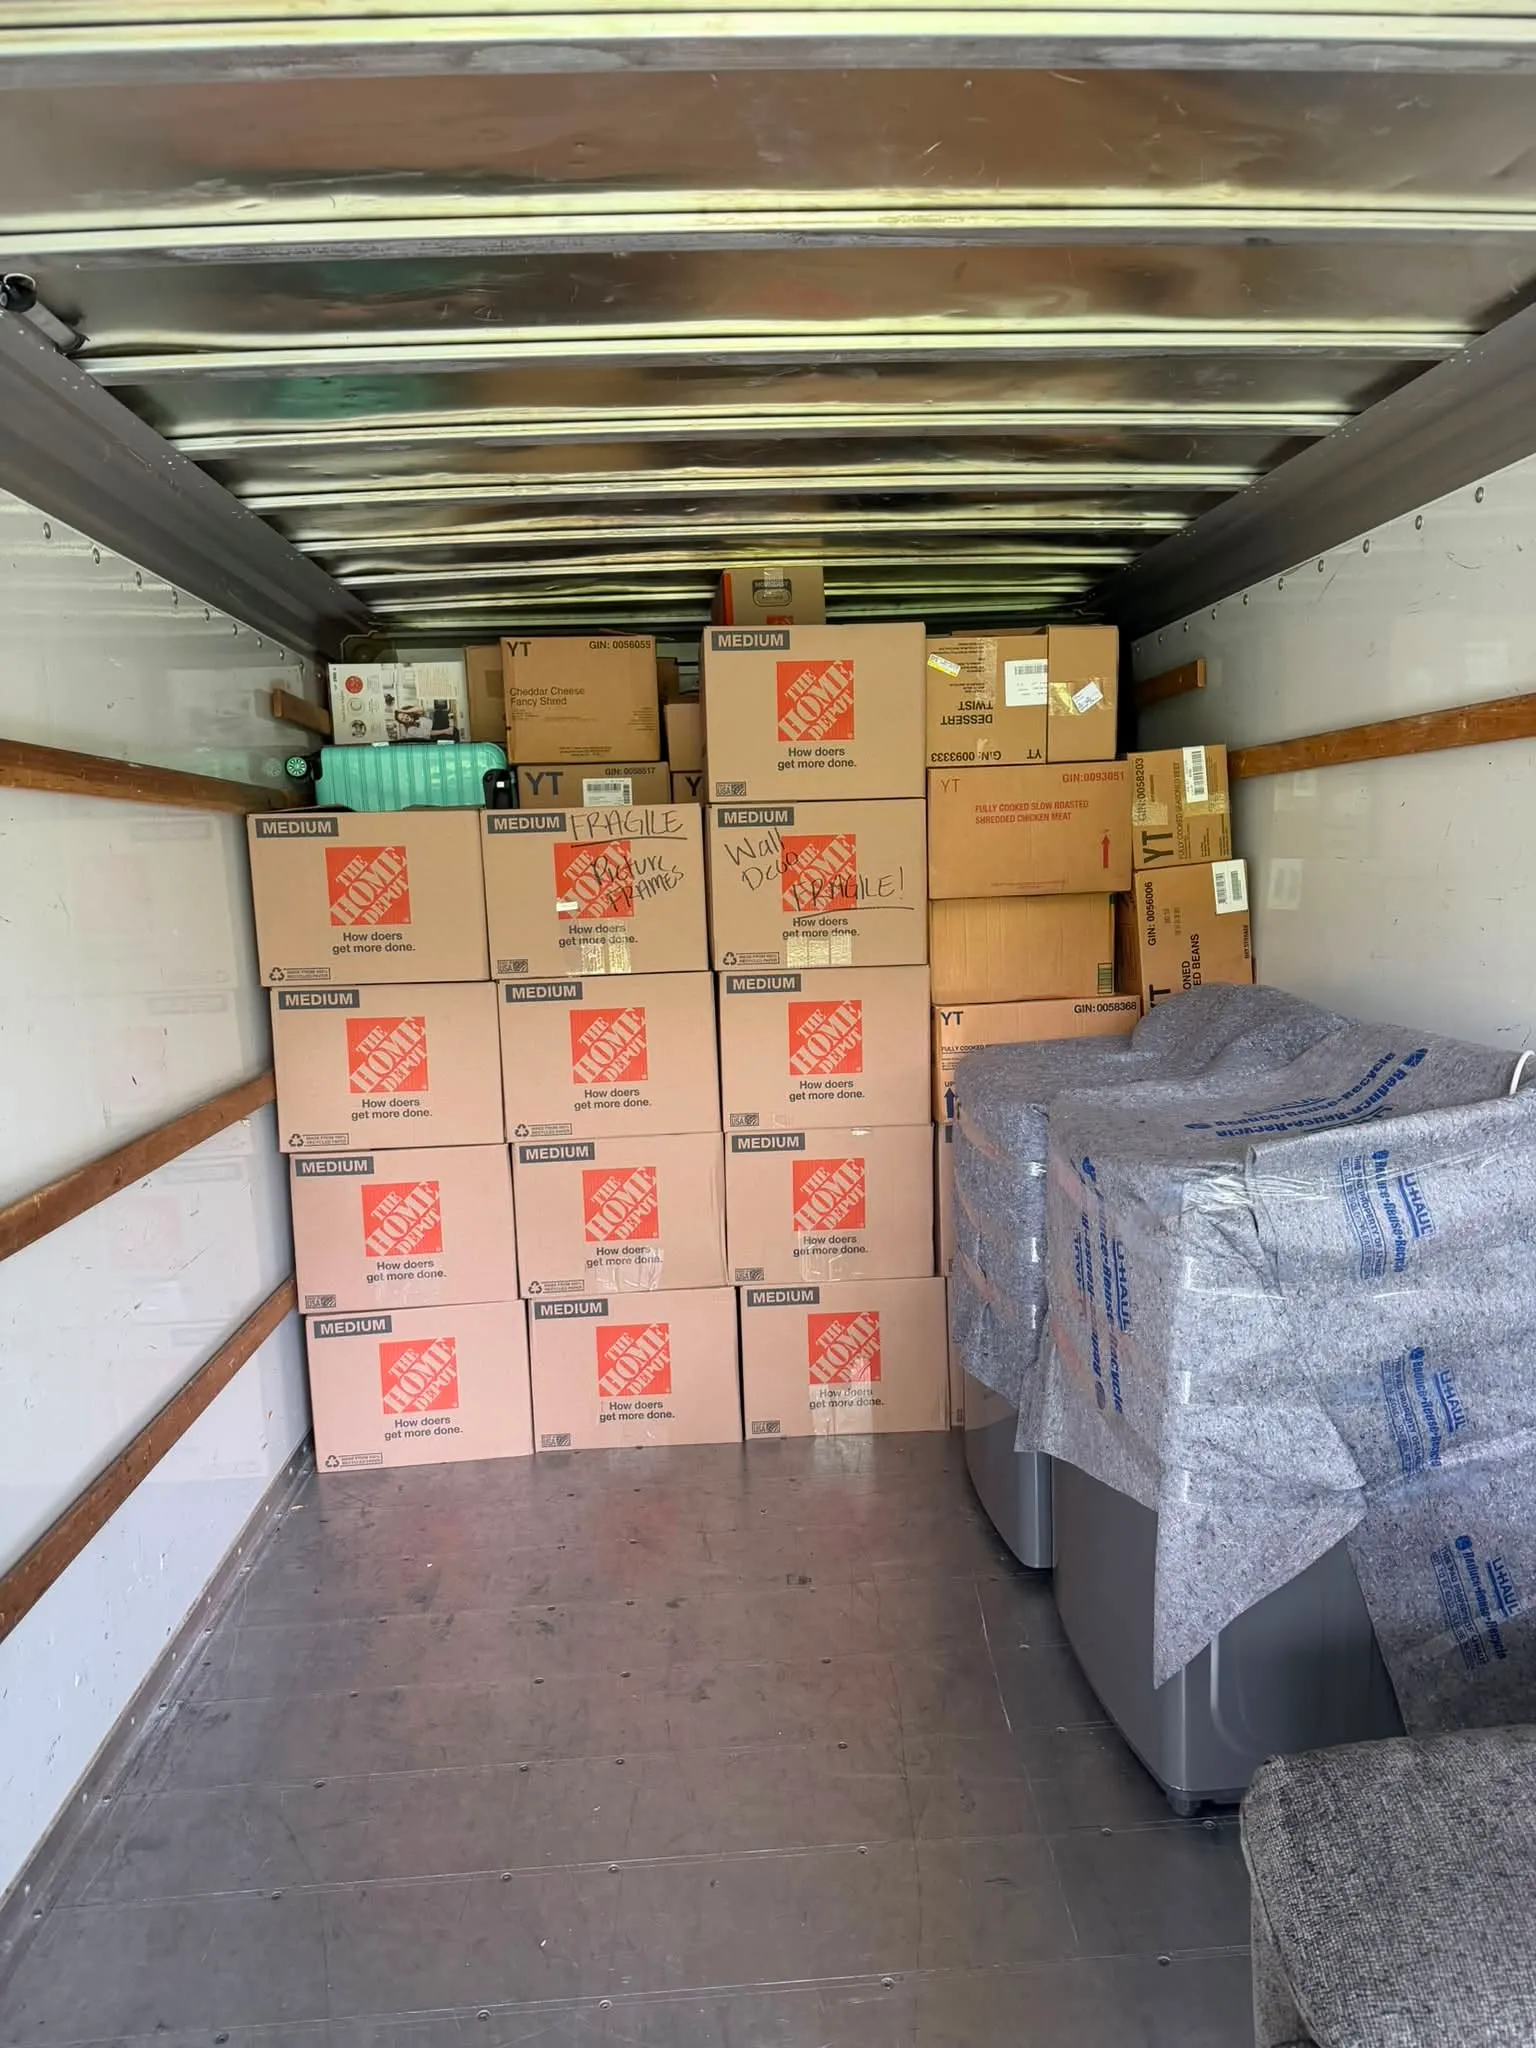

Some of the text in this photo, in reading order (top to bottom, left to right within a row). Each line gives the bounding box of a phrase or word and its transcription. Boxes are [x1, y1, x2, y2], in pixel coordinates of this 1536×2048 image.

[589, 641, 610, 649] GIN:
[718, 634, 784, 648] MEDIUM
[507, 642, 532, 656] YT
[510, 687, 585, 697] Cheddar Cheese
[785, 669, 816, 701] THE
[510, 697, 537, 706] Fancy
[779, 658, 854, 741] HOME
[958, 701, 993, 710] TWIST
[808, 690, 854, 740] DEPOT
[941, 715, 993, 725] DESSERT
[788, 747, 845, 757] How doers
[931, 752, 974, 761] 0093333
[1027, 749, 1042, 758] YT
[778, 758, 856, 770] get more done.
[525, 772, 564, 795] YT
[941, 779, 960, 793] YT
[975, 800, 1089, 813] FULLY COOKED SLOW ROASTED
[494, 817, 560, 830] MEDIUM
[724, 810, 788, 824] MEDIUM
[975, 815, 1015, 824] SHREDDED
[1017, 814, 1049, 822] CHICKEN
[263, 821, 331, 834] MEDIUM
[571, 810, 684, 840] FRAGILE
[1175, 814, 1184, 840] COOKED
[724, 828, 785, 866] Wall
[1142, 831, 1174, 864] YT
[336, 855, 368, 888] THE
[564, 850, 594, 881] THE
[330, 847, 407, 925] HOME
[791, 867, 904, 912] FRAGILE!
[362, 875, 409, 925] DEPOT
[793, 917, 848, 927] How doers
[343, 932, 402, 941] How doers
[569, 925, 592, 934] How
[802, 929, 828, 938] more
[1148, 923, 1157, 946] GIN:
[333, 942, 416, 955] get more done.
[1190, 933, 1201, 969] BEANS
[1181, 960, 1192, 990] ONED
[733, 977, 795, 990] MEDIUM
[512, 985, 576, 999] MEDIUM
[285, 993, 353, 1007] MEDIUM
[797, 1009, 826, 1038] THE
[941, 1011, 964, 1025] YT
[579, 1016, 609, 1047] THE
[790, 1000, 862, 1075] HOME
[356, 1026, 387, 1055] THE
[574, 1008, 646, 1083] HOME
[350, 1017, 426, 1093] HOME
[818, 1027, 862, 1074] DEPOT
[603, 1034, 647, 1082] DEPOT
[381, 1044, 428, 1091] DEPOT
[800, 1080, 853, 1089] How doers
[585, 1089, 640, 1099] How doers
[789, 1090, 864, 1102] get more done.
[362, 1098, 420, 1109] How doers
[574, 1098, 652, 1111] get more done.
[351, 1108, 432, 1121] get more done.
[738, 1136, 799, 1149] MEDIUM
[526, 1146, 589, 1160] MEDIUM
[302, 1160, 368, 1173] MEDIUM
[800, 1167, 830, 1196] THE
[591, 1176, 622, 1206] THE
[794, 1159, 865, 1231] HOME
[371, 1191, 403, 1221] THE
[585, 1167, 657, 1241] HOME
[822, 1184, 865, 1230] DEPOT
[365, 1181, 439, 1256] HOME
[615, 1193, 658, 1240] DEPOT
[1358, 1191, 1379, 1234] PROPERTY
[396, 1208, 441, 1255] DEPOT
[829, 1235, 857, 1244] doers
[596, 1247, 619, 1256] How
[812, 1245, 868, 1255] more done.
[377, 1260, 434, 1270] How doers
[587, 1257, 632, 1268] get more
[367, 1270, 446, 1283] get more done.
[753, 1290, 813, 1303] MEDIUM
[540, 1302, 602, 1316] MEDIUM
[320, 1319, 385, 1335] MEDIUM
[816, 1320, 845, 1348] THE
[604, 1332, 635, 1361] THE
[809, 1312, 880, 1383] HOME
[388, 1348, 420, 1379] THE
[599, 1323, 671, 1396] HOME
[384, 1337, 457, 1414] HOME
[627, 1350, 671, 1395] DEPOT
[414, 1364, 457, 1411] DEPOT
[609, 1401, 663, 1410] How doers
[809, 1401, 826, 1410] get
[395, 1417, 450, 1428] How doers
[600, 1411, 675, 1422] get more done.
[385, 1426, 463, 1441] get more done.
